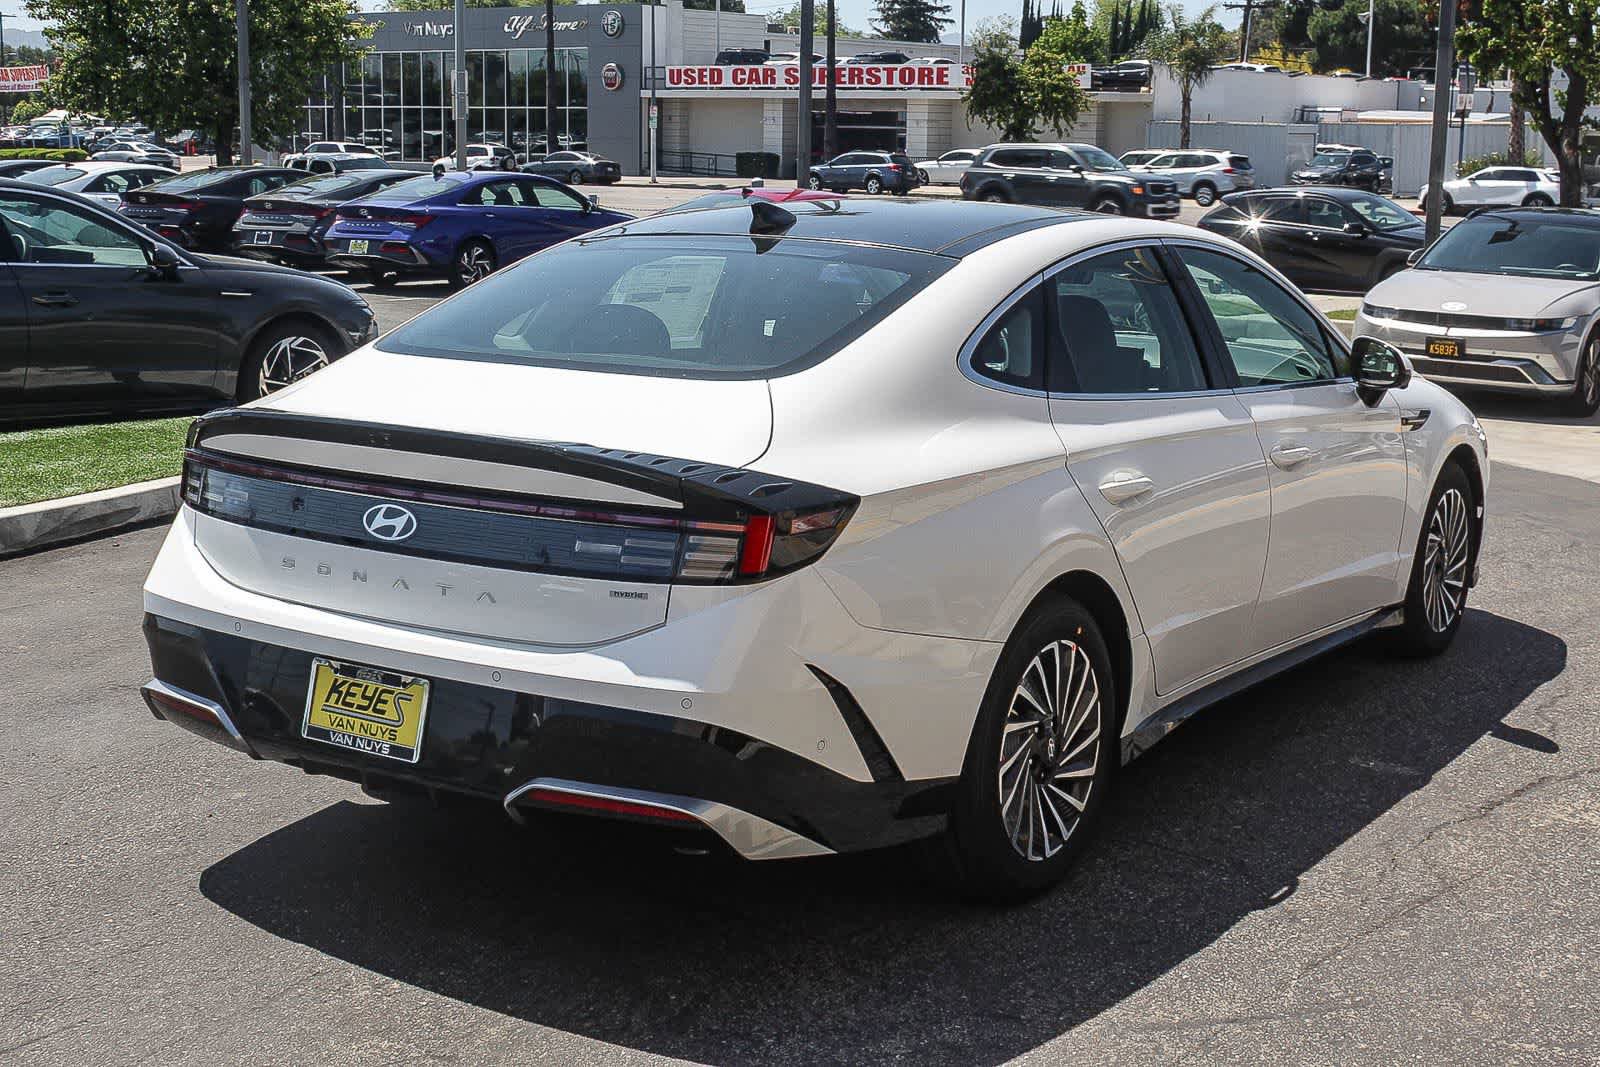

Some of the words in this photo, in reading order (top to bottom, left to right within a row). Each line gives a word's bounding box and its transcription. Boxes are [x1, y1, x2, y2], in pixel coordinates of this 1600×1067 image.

[425, 21, 454, 38] Nuys
[668, 67, 723, 85] USED
[732, 67, 776, 85] CAR
[1430, 343, 1459, 356] K583F1
[281, 556, 496, 604] SONATA
[322, 677, 414, 728] KEYES
[328, 714, 355, 731] VAN
[358, 721, 398, 742] NUYS
[330, 731, 354, 746] VAN
[355, 737, 391, 755] NUYS
